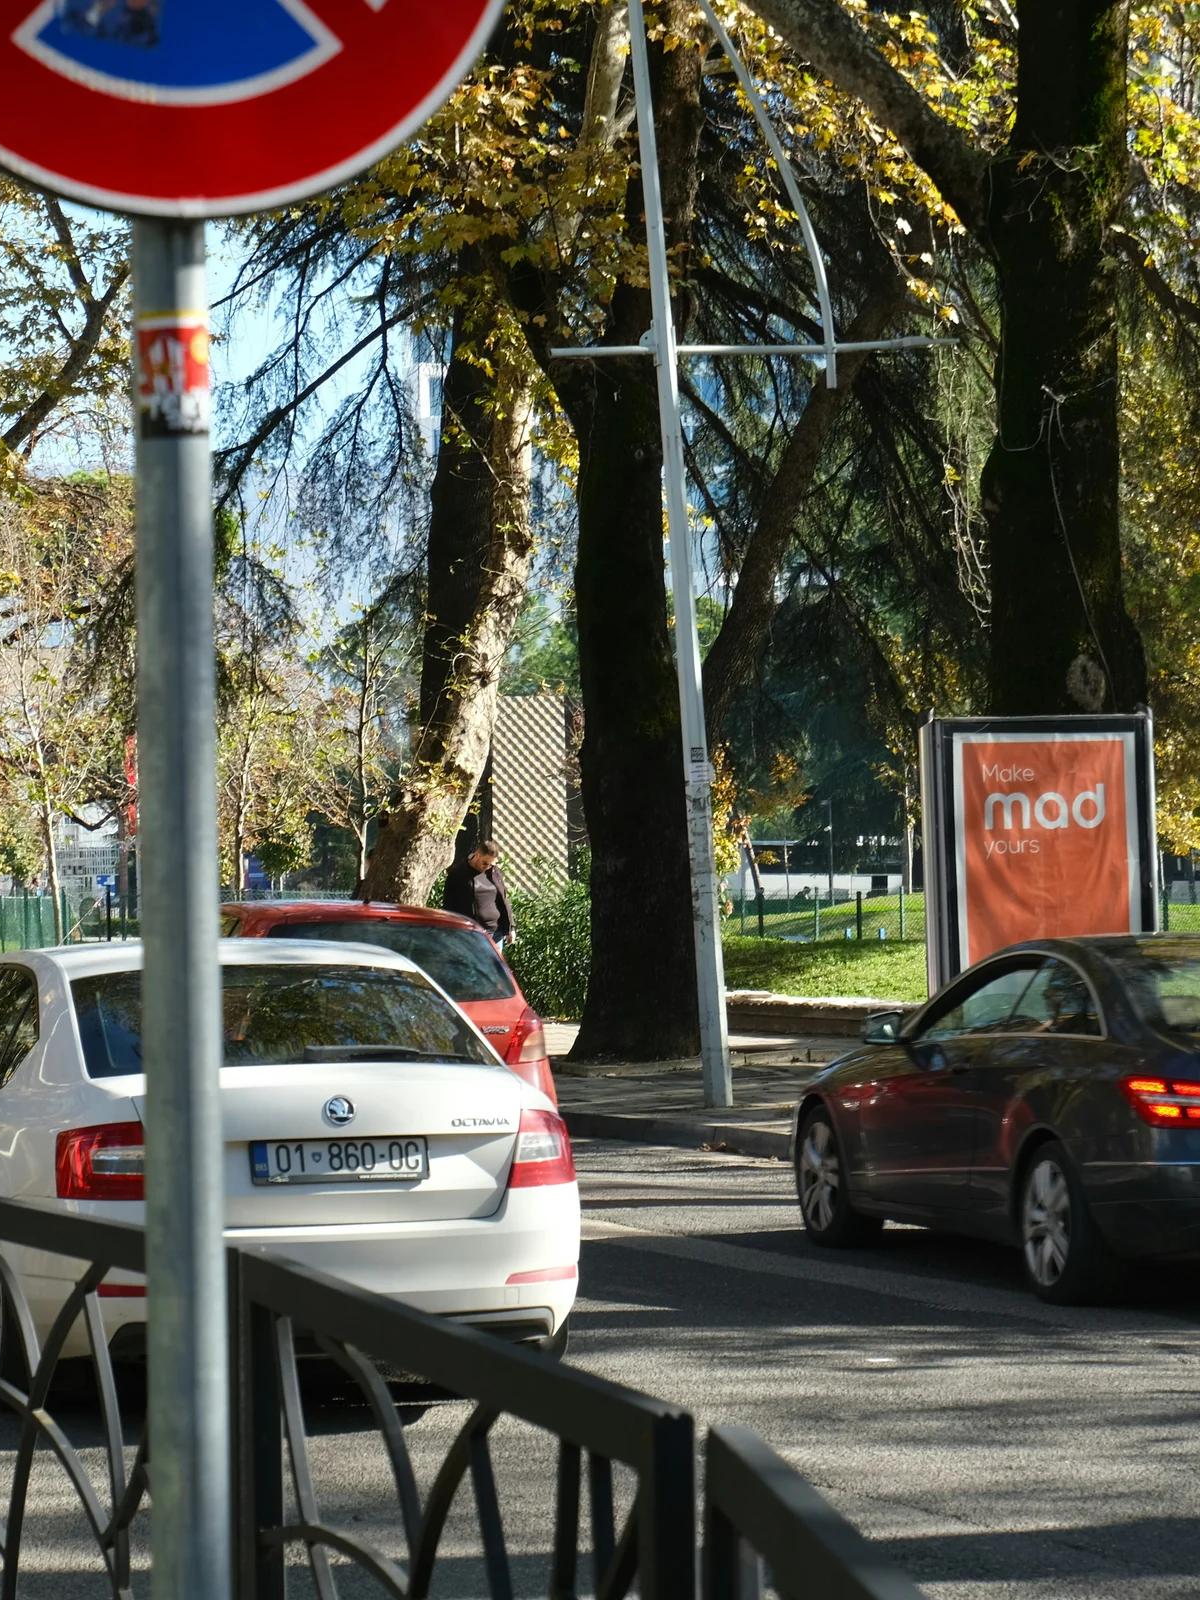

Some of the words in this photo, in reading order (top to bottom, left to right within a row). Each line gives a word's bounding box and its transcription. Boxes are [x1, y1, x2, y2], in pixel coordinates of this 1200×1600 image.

[982, 764, 1034, 782] Make
[984, 783, 1105, 830] mad
[984, 838, 1040, 859] yours
[451, 1117, 510, 1128] OCTAVIA
[274, 1143, 305, 1173] 01
